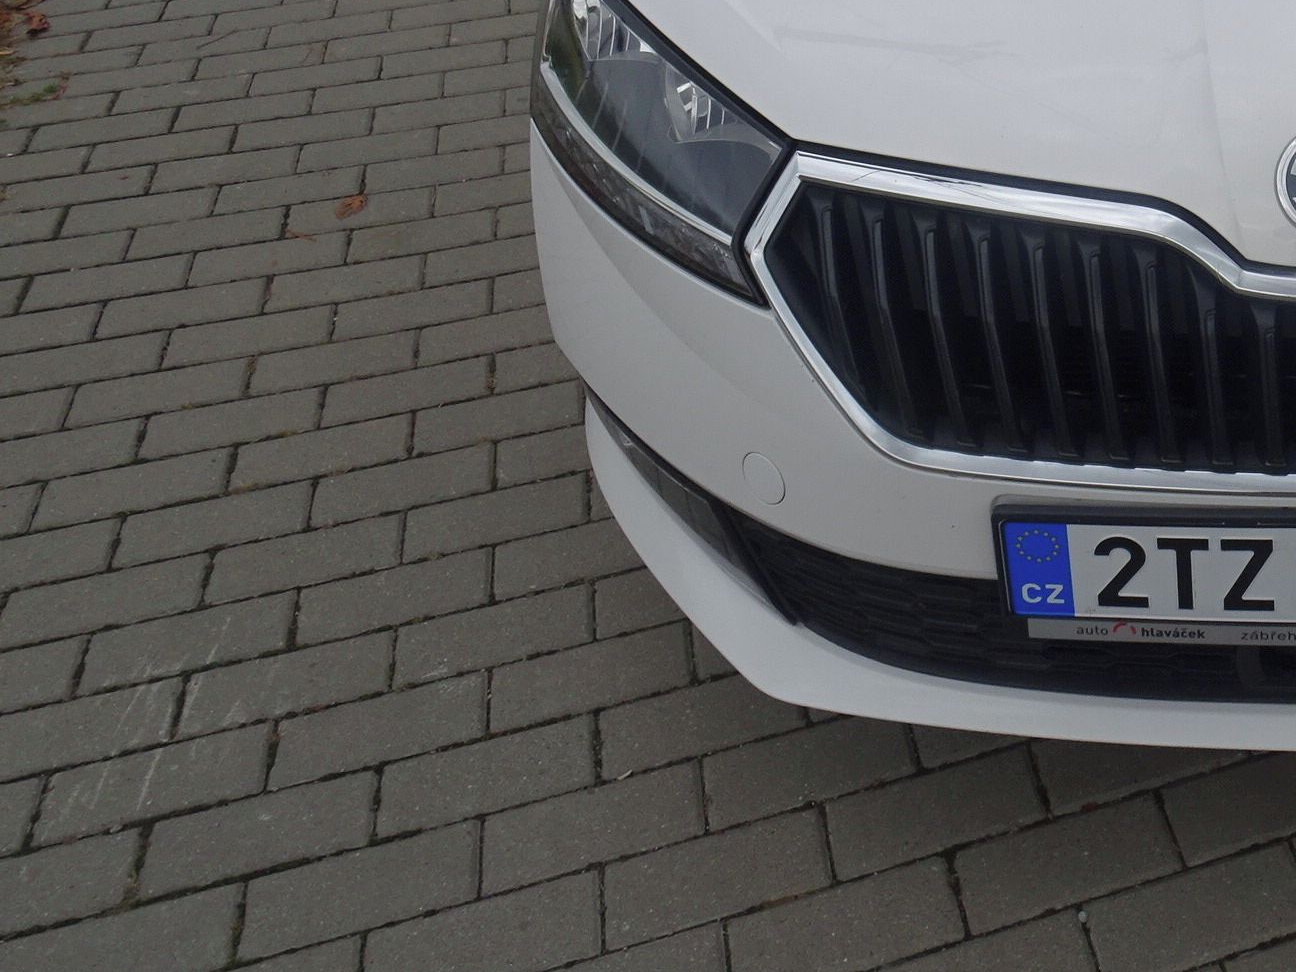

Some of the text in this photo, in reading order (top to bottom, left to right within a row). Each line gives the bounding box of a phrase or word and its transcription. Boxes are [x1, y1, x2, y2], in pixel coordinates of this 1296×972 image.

[1094, 536, 1275, 612] 2TZ
[1021, 583, 1065, 605] CZ
[1076, 625, 1109, 637] auto
[1141, 627, 1206, 640] hlaváček
[1241, 630, 1296, 643] zábřeh
